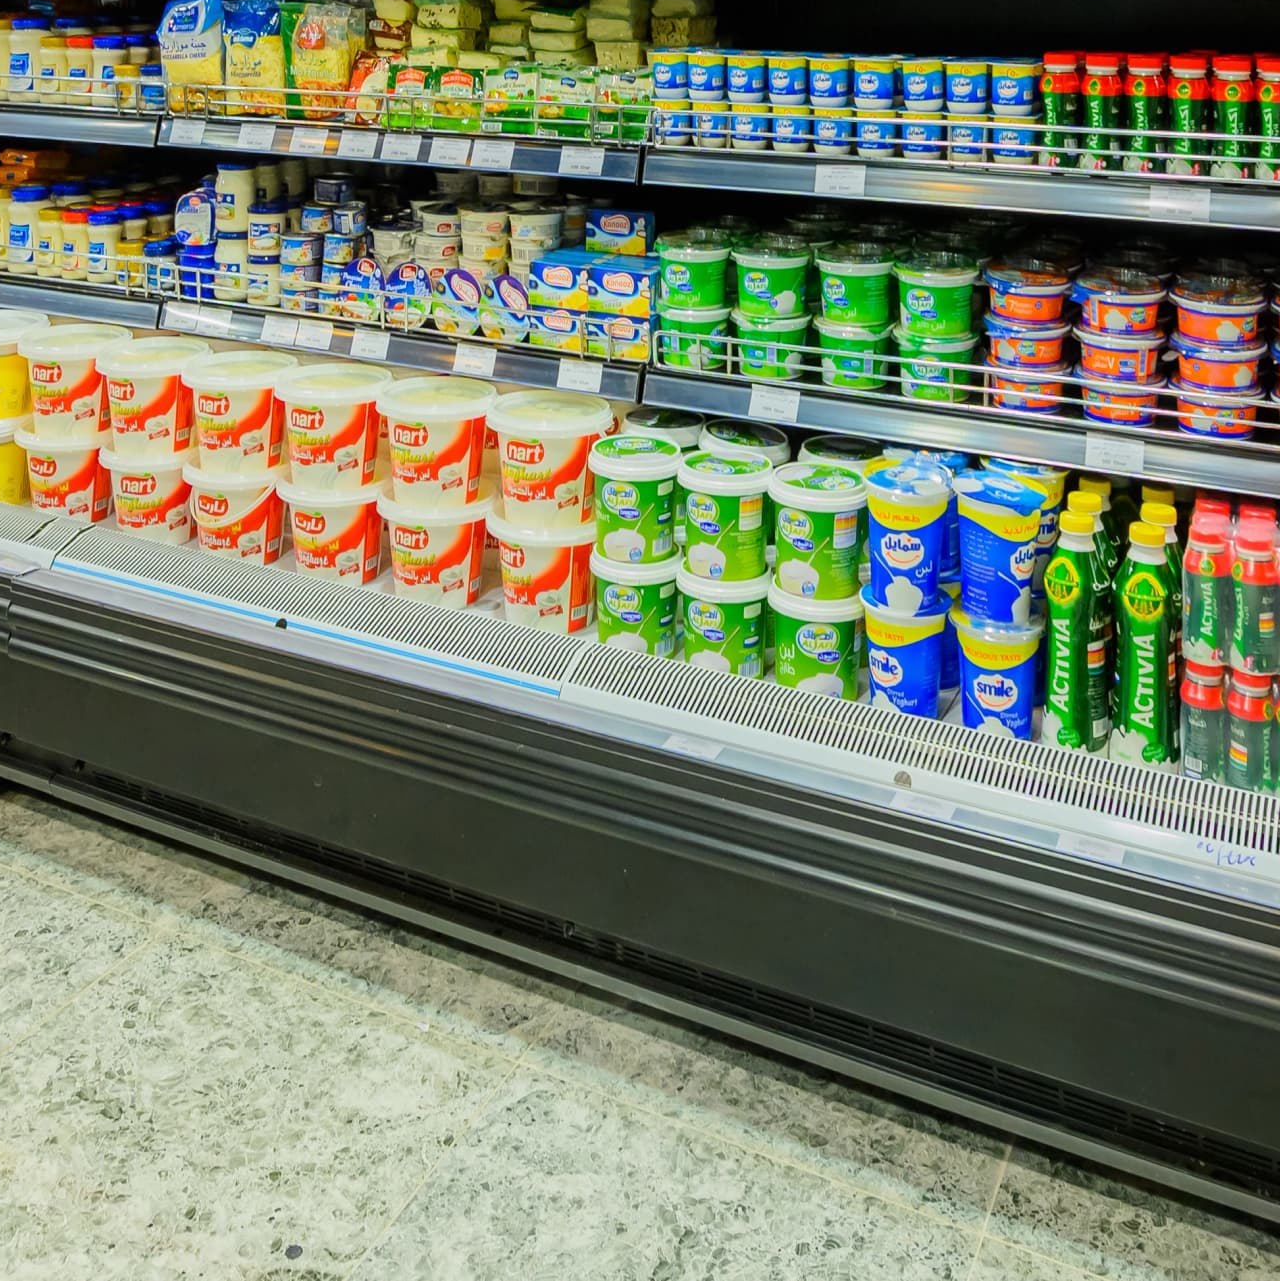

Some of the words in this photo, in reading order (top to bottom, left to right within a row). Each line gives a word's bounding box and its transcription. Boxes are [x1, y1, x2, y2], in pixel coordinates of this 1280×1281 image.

[34, 367, 60, 382] nart
[110, 383, 132, 398] nart
[199, 397, 228, 413] nart
[291, 413, 322, 428] nart
[395, 426, 425, 446] nart
[507, 443, 542, 462] nart
[122, 479, 154, 494] nart
[199, 499, 225, 514] نارت
[295, 516, 322, 532] نارت
[395, 530, 426, 548] nart
[885, 535, 920, 552] سمايل
[915, 560, 933, 578] لبن
[1199, 582, 1212, 638] ACTIVIA
[779, 642, 795, 660] لبن
[871, 655, 898, 676] smile
[1049, 619, 1070, 712] ACTIVIA
[976, 679, 1013, 697] smile
[1130, 633, 1155, 728] ACTIVIA
[892, 696, 918, 707] Yoghurt
